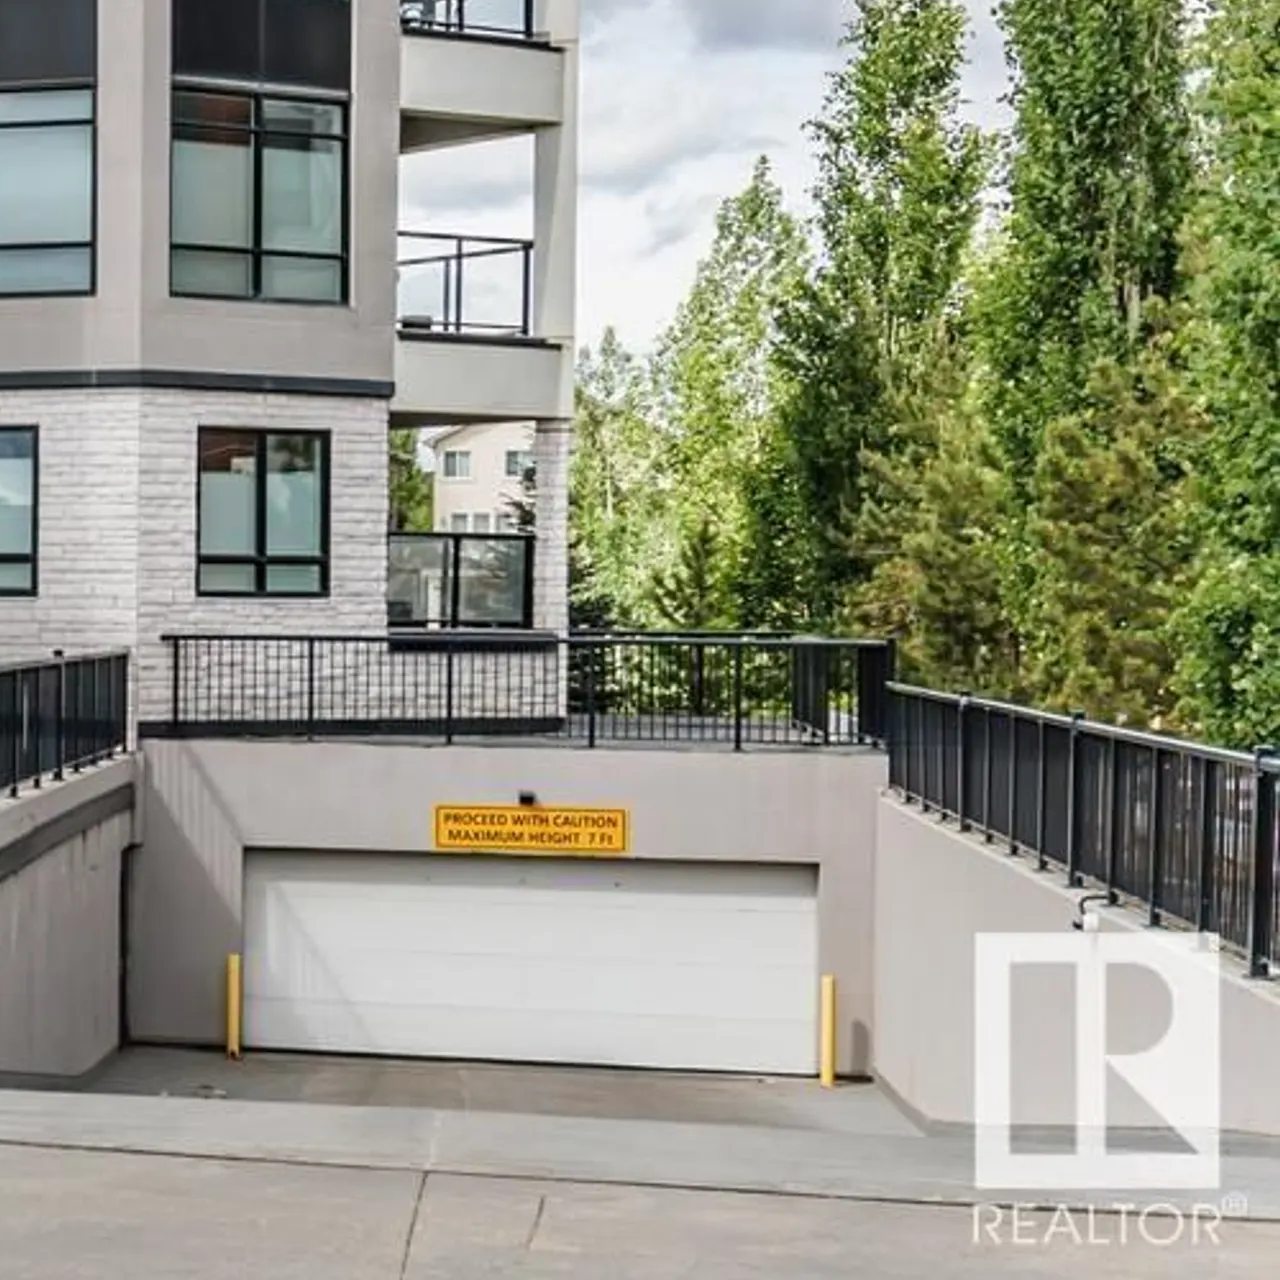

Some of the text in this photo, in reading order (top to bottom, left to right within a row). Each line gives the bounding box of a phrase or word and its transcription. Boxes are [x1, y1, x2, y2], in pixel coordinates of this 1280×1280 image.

[444, 812, 618, 829] PROCEED WITH CAUTION
[448, 828, 524, 844] MAXIMUM
[528, 831, 580, 845] HEIGHT
[587, 832, 596, 844] 7
